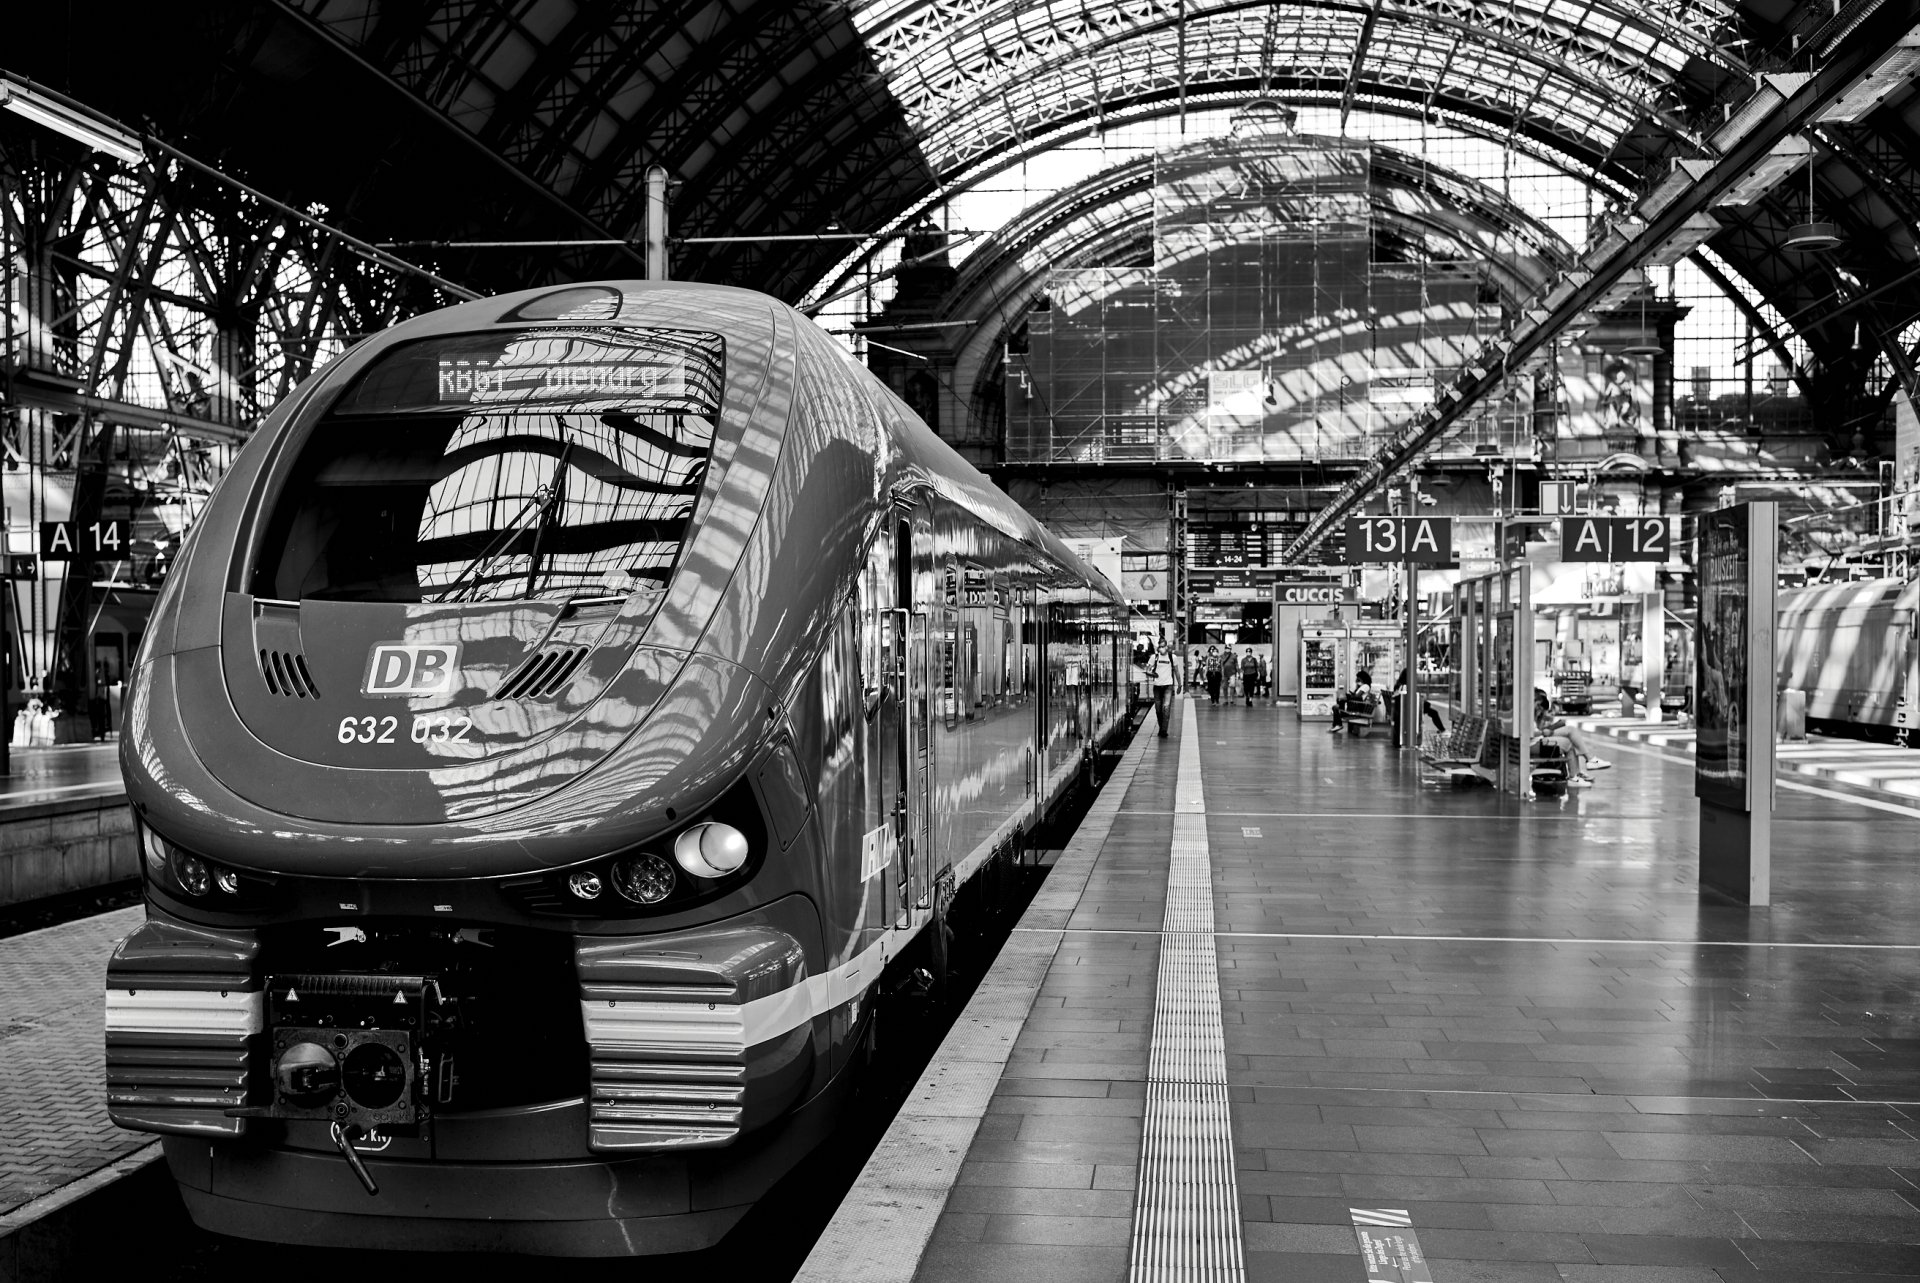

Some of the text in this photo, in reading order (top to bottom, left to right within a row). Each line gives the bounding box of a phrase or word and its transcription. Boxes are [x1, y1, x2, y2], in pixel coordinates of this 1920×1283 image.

[50, 521, 121, 552] A 14
[1359, 519, 1438, 552] 13 A
[1575, 519, 1664, 552] A 12
[1285, 588, 1345, 602] CUCCIS
[374, 650, 448, 689] DB
[337, 716, 473, 743] 632 032
